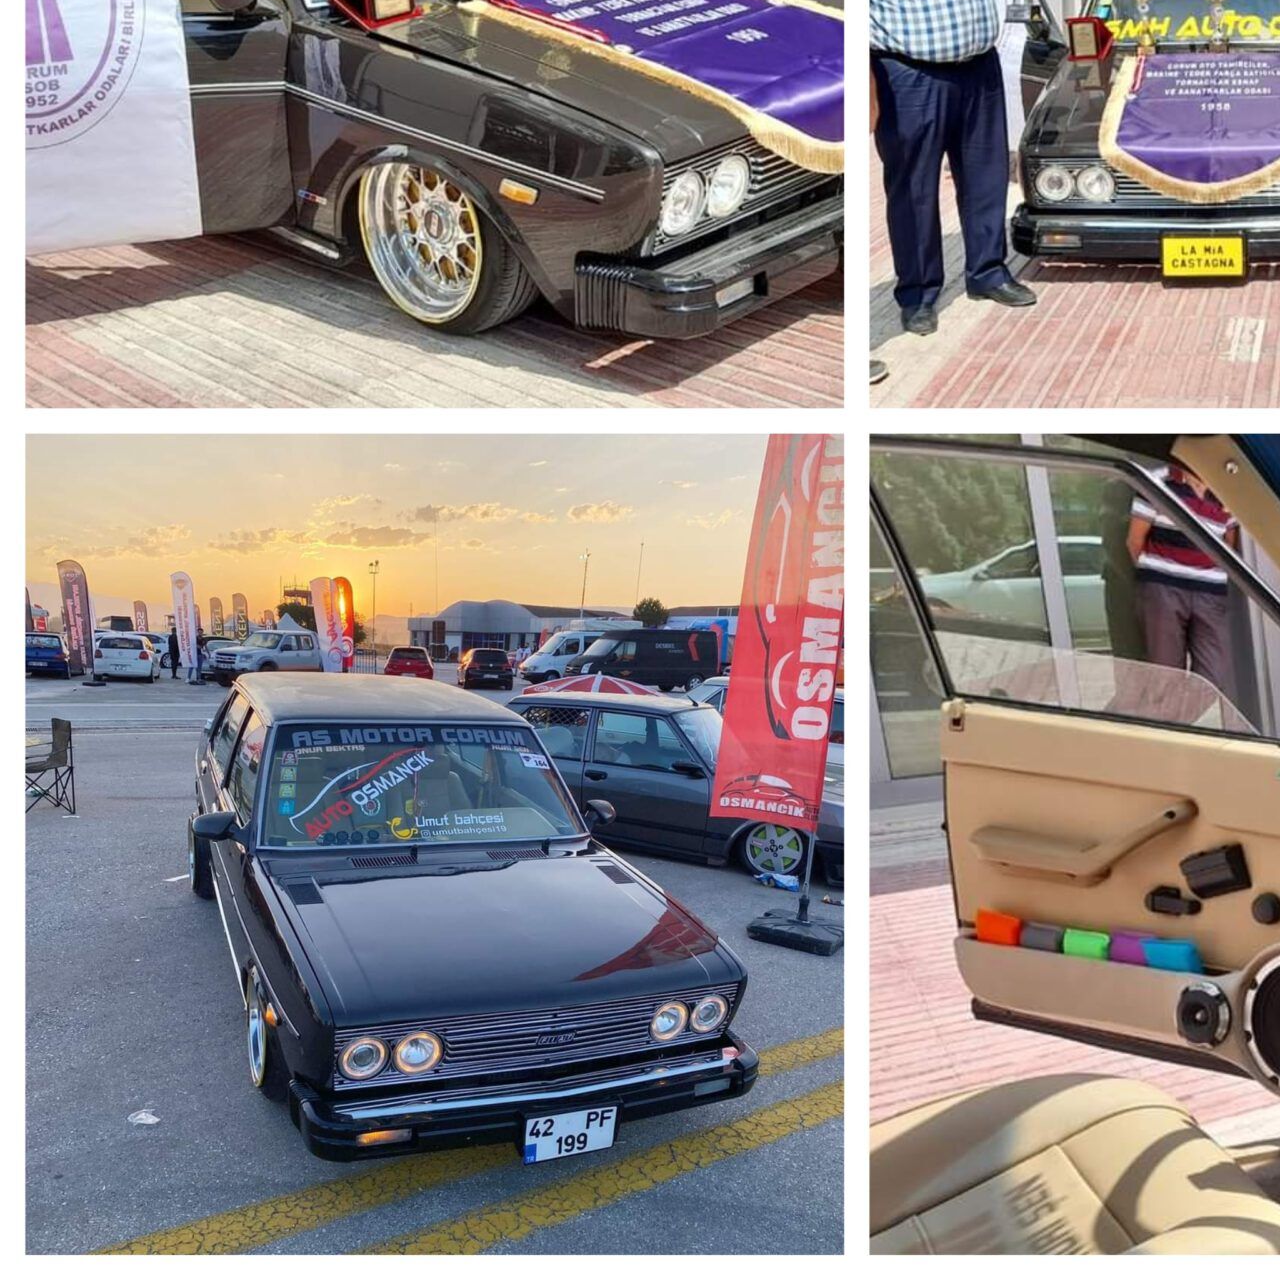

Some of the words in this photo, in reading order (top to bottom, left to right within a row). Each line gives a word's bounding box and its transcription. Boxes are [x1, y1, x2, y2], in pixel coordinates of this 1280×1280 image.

[26, 62, 69, 79] RUM
[26, 92, 60, 108] 952
[26, 102, 98, 137] TKARLAR
[1180, 245, 1197, 256] LA
[1171, 258, 1235, 269] CASTAGNA
[292, 731, 332, 747] AS
[340, 727, 434, 745] MOTOR
[304, 800, 353, 840] AUTO
[351, 750, 434, 806] OSMANCIK
[720, 796, 806, 818] OSMANCIK
[415, 815, 450, 829] Umut
[454, 812, 505, 827] bahçesi
[432, 826, 508, 838] umutbahçesi19
[528, 1118, 555, 1139] 42
[586, 1108, 615, 1129] PF
[556, 1132, 589, 1155] 199
